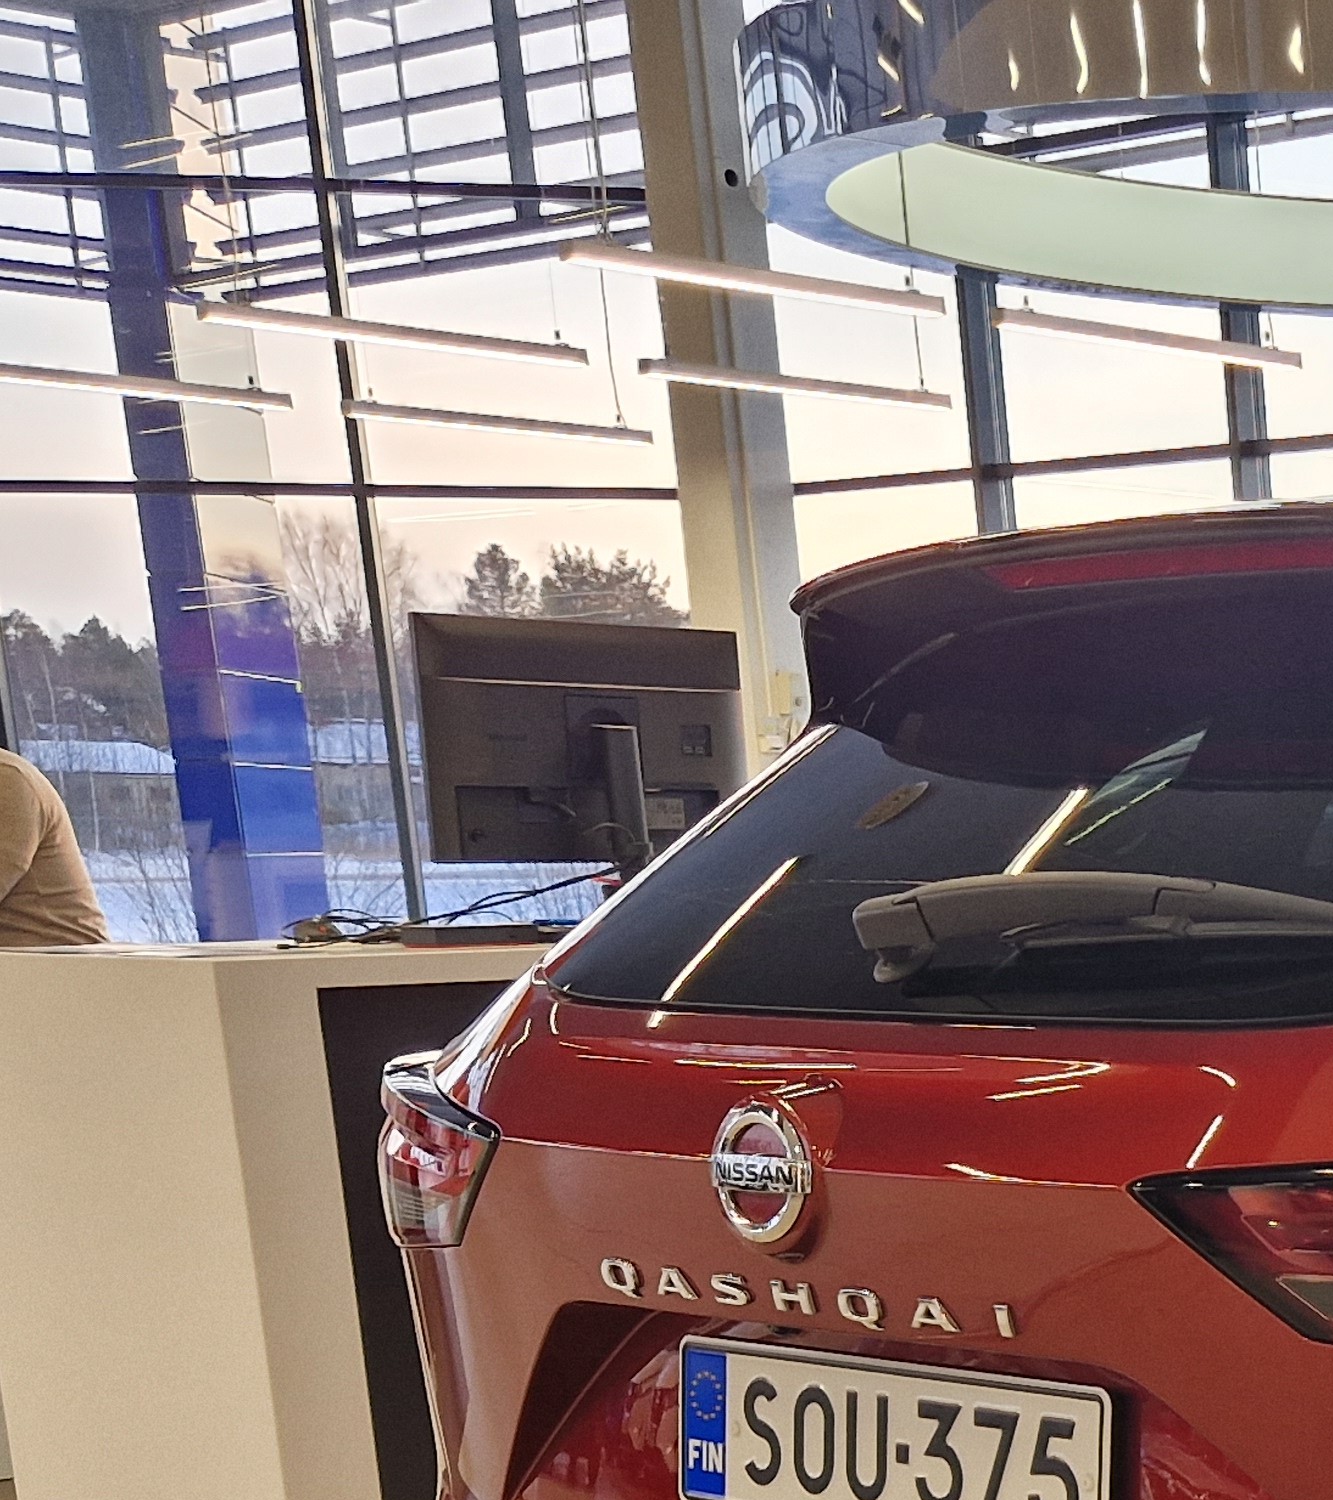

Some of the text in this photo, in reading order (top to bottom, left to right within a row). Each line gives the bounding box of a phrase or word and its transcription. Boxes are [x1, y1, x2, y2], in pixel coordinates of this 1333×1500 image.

[714, 1158, 794, 1186] NISSAN
[599, 1257, 1016, 1339] QASHQAI
[687, 1437, 724, 1475] FIN
